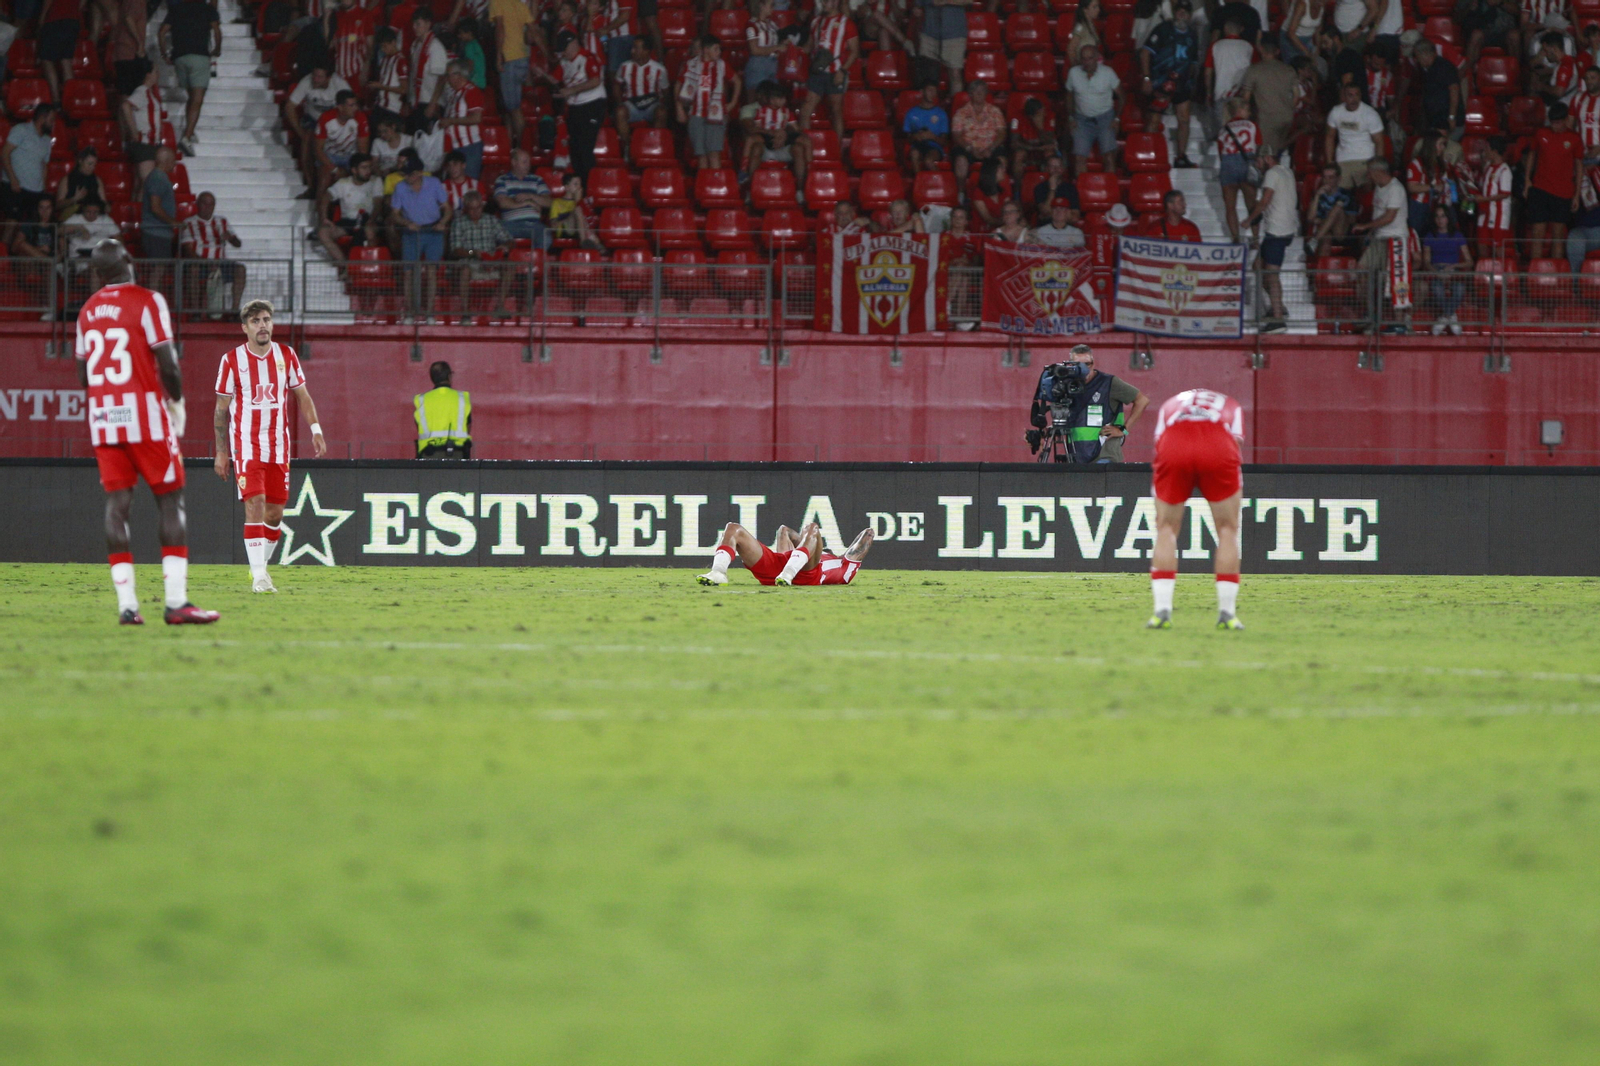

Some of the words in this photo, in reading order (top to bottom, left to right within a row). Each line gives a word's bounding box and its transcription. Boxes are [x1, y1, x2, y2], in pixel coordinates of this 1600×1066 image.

[1033, 314, 1102, 335] ALMERIA
[84, 328, 132, 386] 23
[362, 491, 850, 557] ESTRELLA
[866, 512, 925, 541] DE
[937, 496, 1379, 561] LEVANTE
